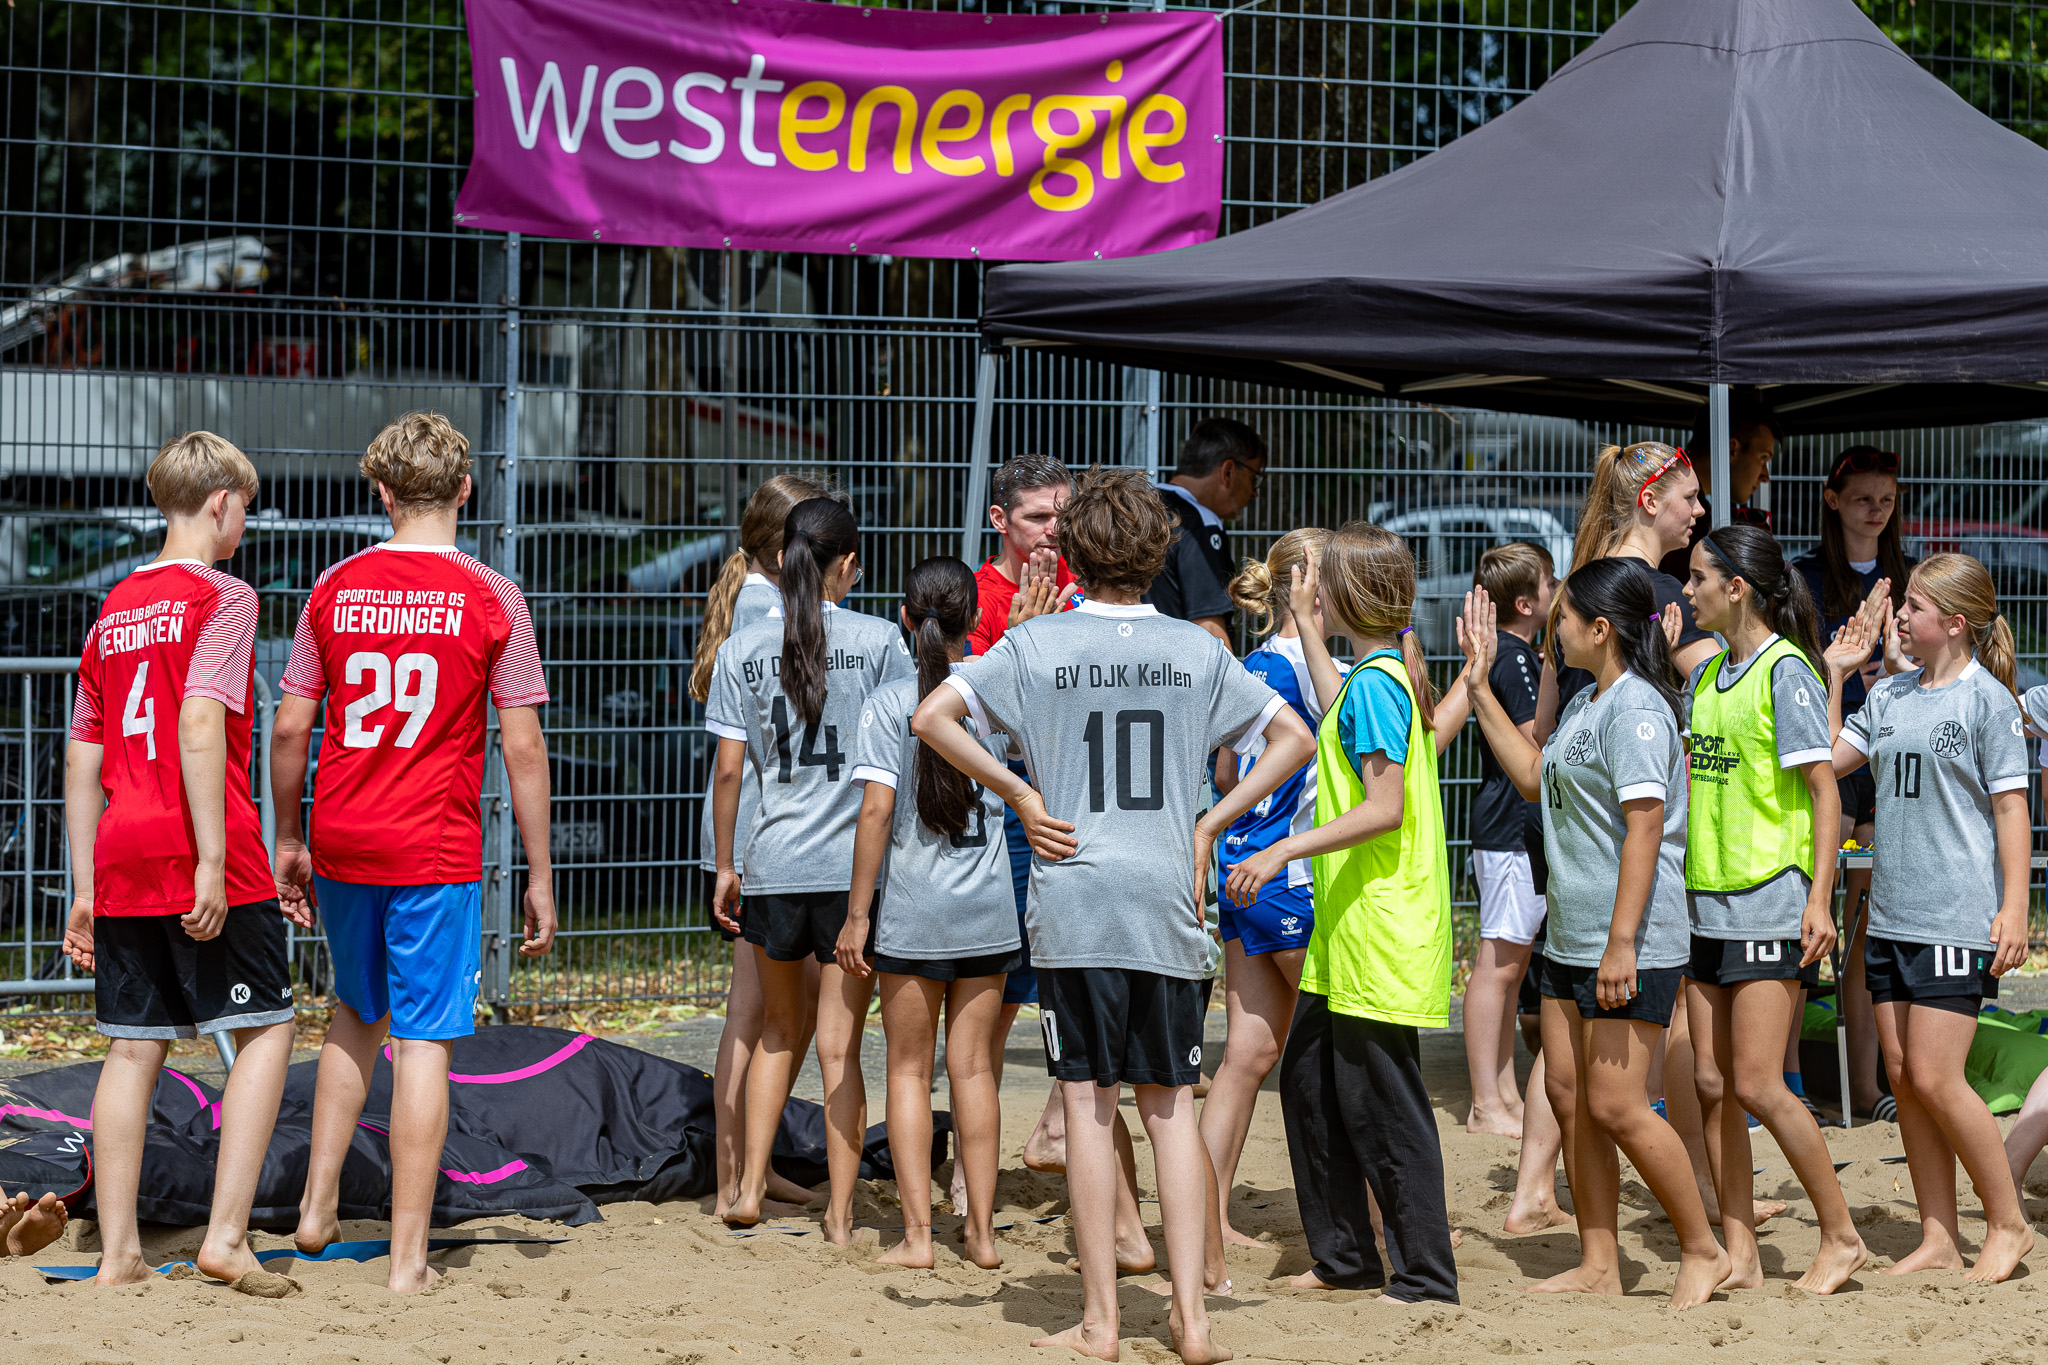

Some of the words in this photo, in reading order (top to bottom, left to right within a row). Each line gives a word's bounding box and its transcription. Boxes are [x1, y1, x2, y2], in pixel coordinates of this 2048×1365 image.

[499, 54, 1188, 212] westenergie
[98, 607, 145, 634] SPORTCLUB
[144, 600, 171, 620] BAYER
[333, 605, 463, 637] UERDINGEN
[335, 589, 403, 605] SPORTCLUB
[405, 590, 446, 606] BAYER
[447, 592, 466, 608] 05
[98, 616, 184, 661] UERDINGEN
[742, 658, 764, 684] BV
[825, 649, 865, 672] ellen
[1055, 665, 1081, 691] BV
[1089, 664, 1130, 688] DJK
[1137, 662, 1192, 689] Kellen
[122, 660, 157, 761] 4
[343, 651, 439, 749] 29
[771, 690, 846, 784] 14
[1082, 709, 1165, 813] 10
[1690, 752, 1740, 774] EDARF
[1893, 751, 1921, 799] 10
[1545, 760, 1563, 810] 13
